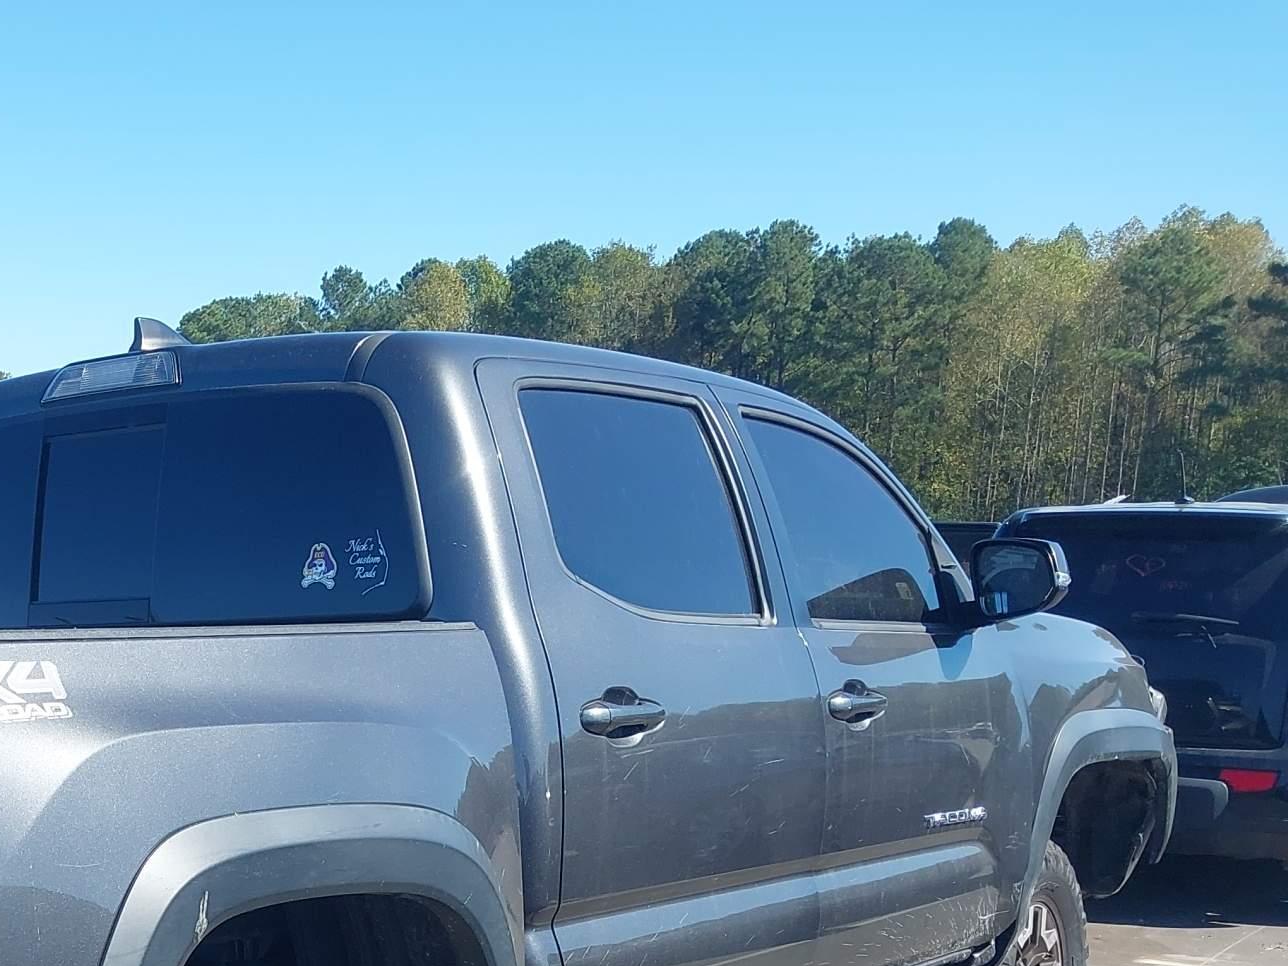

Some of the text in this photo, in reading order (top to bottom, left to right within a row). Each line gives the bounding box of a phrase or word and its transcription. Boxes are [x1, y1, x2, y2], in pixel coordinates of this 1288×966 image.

[345, 538, 374, 552] Nick's
[349, 553, 381, 565] Custom
[924, 806, 987, 829] TACO
